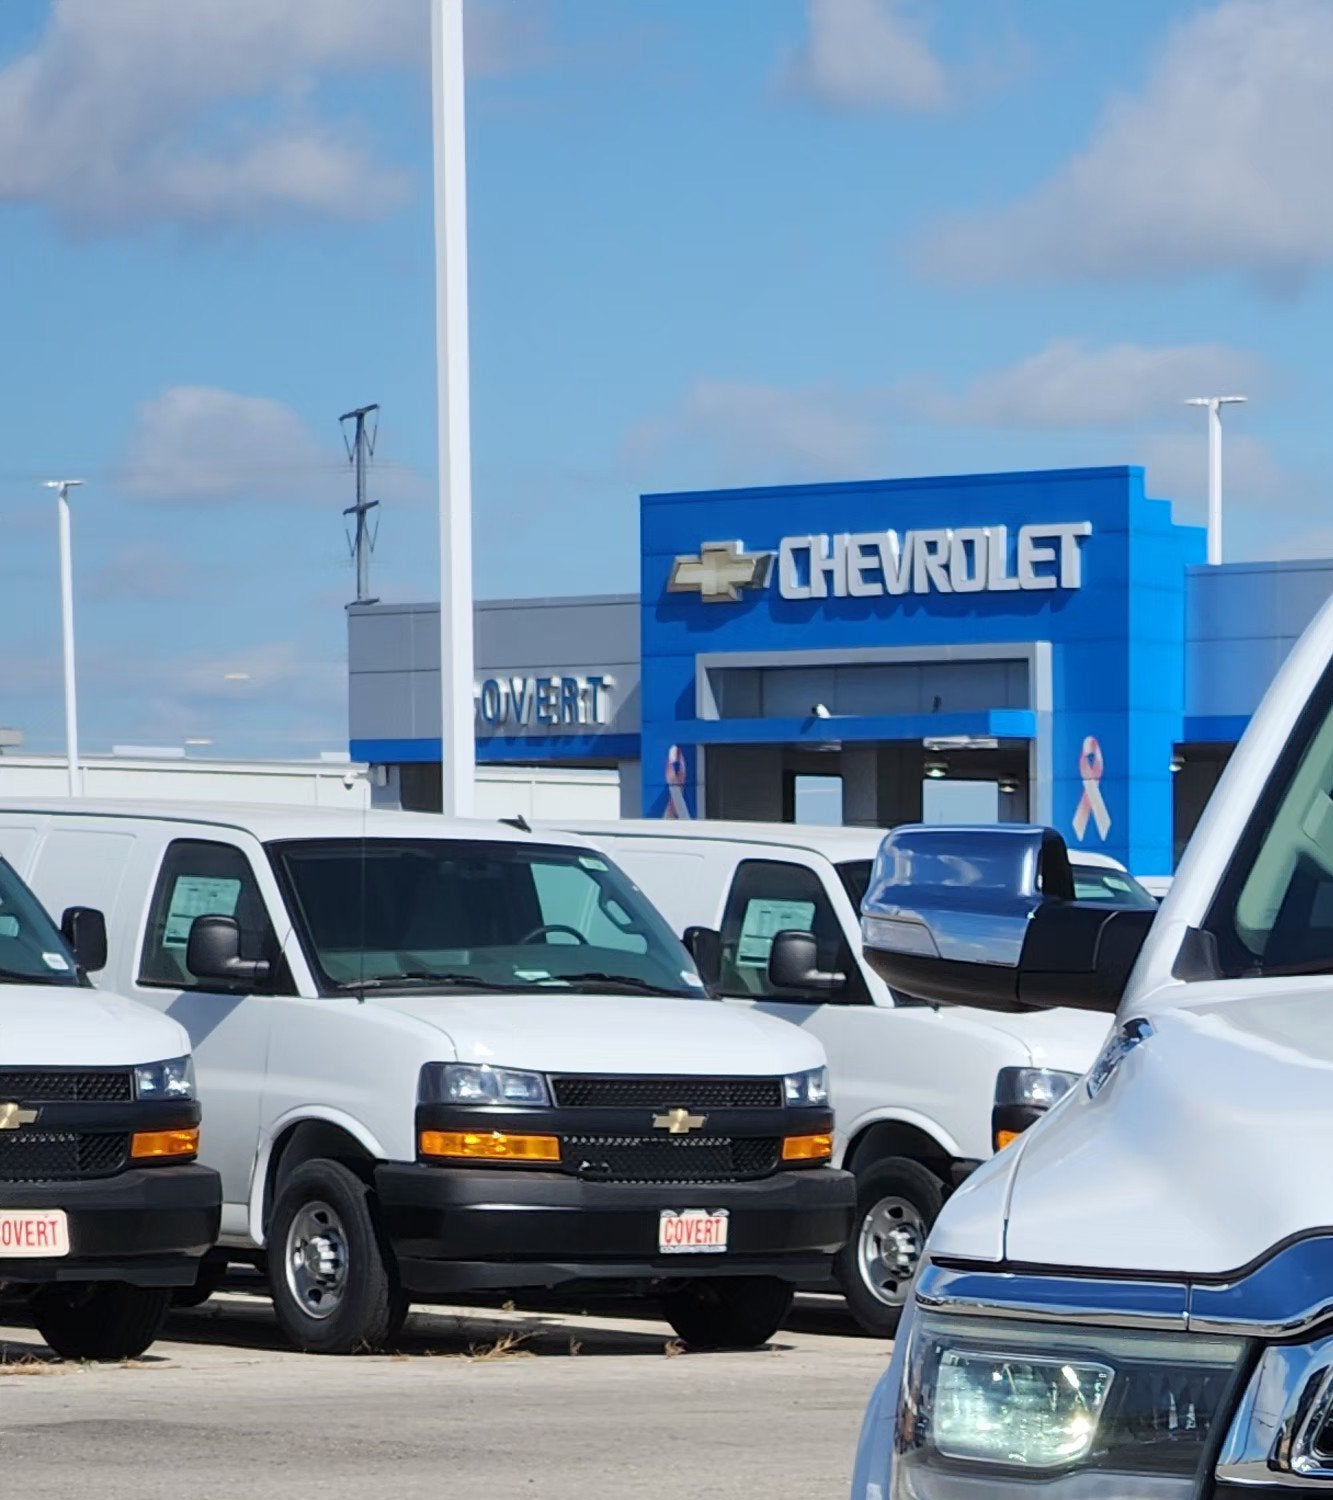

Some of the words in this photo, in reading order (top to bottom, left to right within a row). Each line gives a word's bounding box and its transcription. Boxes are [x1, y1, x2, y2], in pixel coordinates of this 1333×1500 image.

[779, 521, 1092, 600] CHEVROLET
[475, 674, 614, 726] OVERT
[1, 1220, 58, 1247] OVERT
[664, 1218, 721, 1244] COVERT
